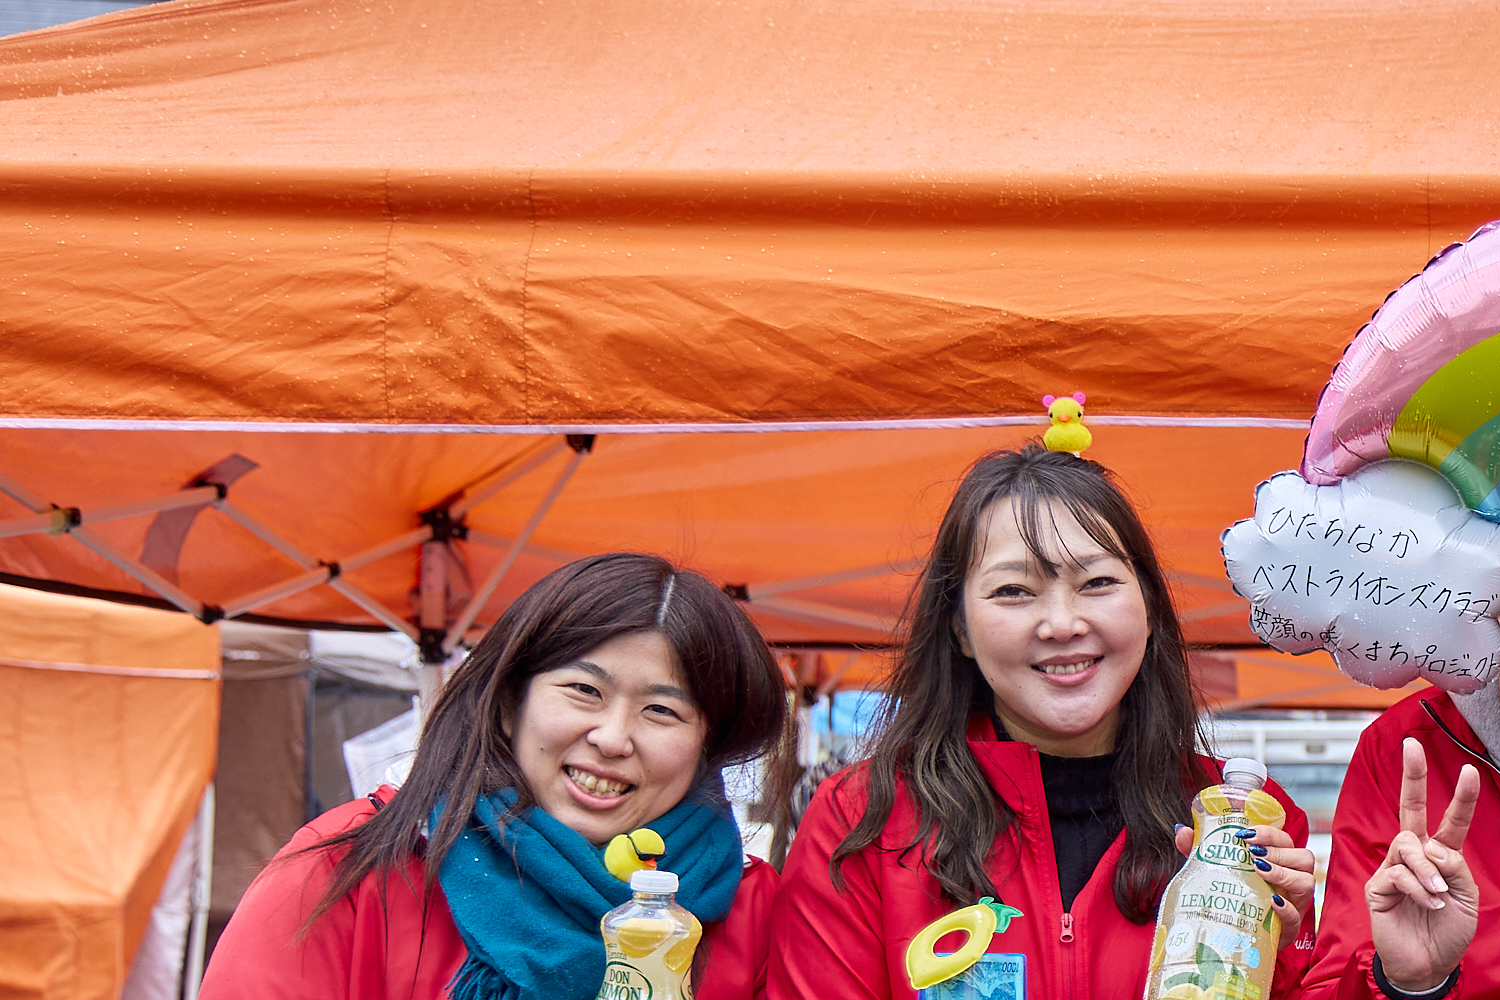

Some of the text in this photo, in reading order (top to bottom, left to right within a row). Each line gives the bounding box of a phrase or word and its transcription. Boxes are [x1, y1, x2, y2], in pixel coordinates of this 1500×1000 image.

[1268, 506, 1419, 559] ひたちなか
[1252, 564, 1498, 622] ベストライオンズクラブ
[1223, 815, 1250, 826] Lemons
[1210, 880, 1247, 898] STILL
[1181, 894, 1265, 922] LEMONADE
[1203, 910, 1234, 926] SQUEEZED
[1237, 917, 1259, 934] LEMONS
[1210, 928, 1251, 953] Light
[609, 968, 631, 985] DON
[1002, 962, 1019, 973] 1000
